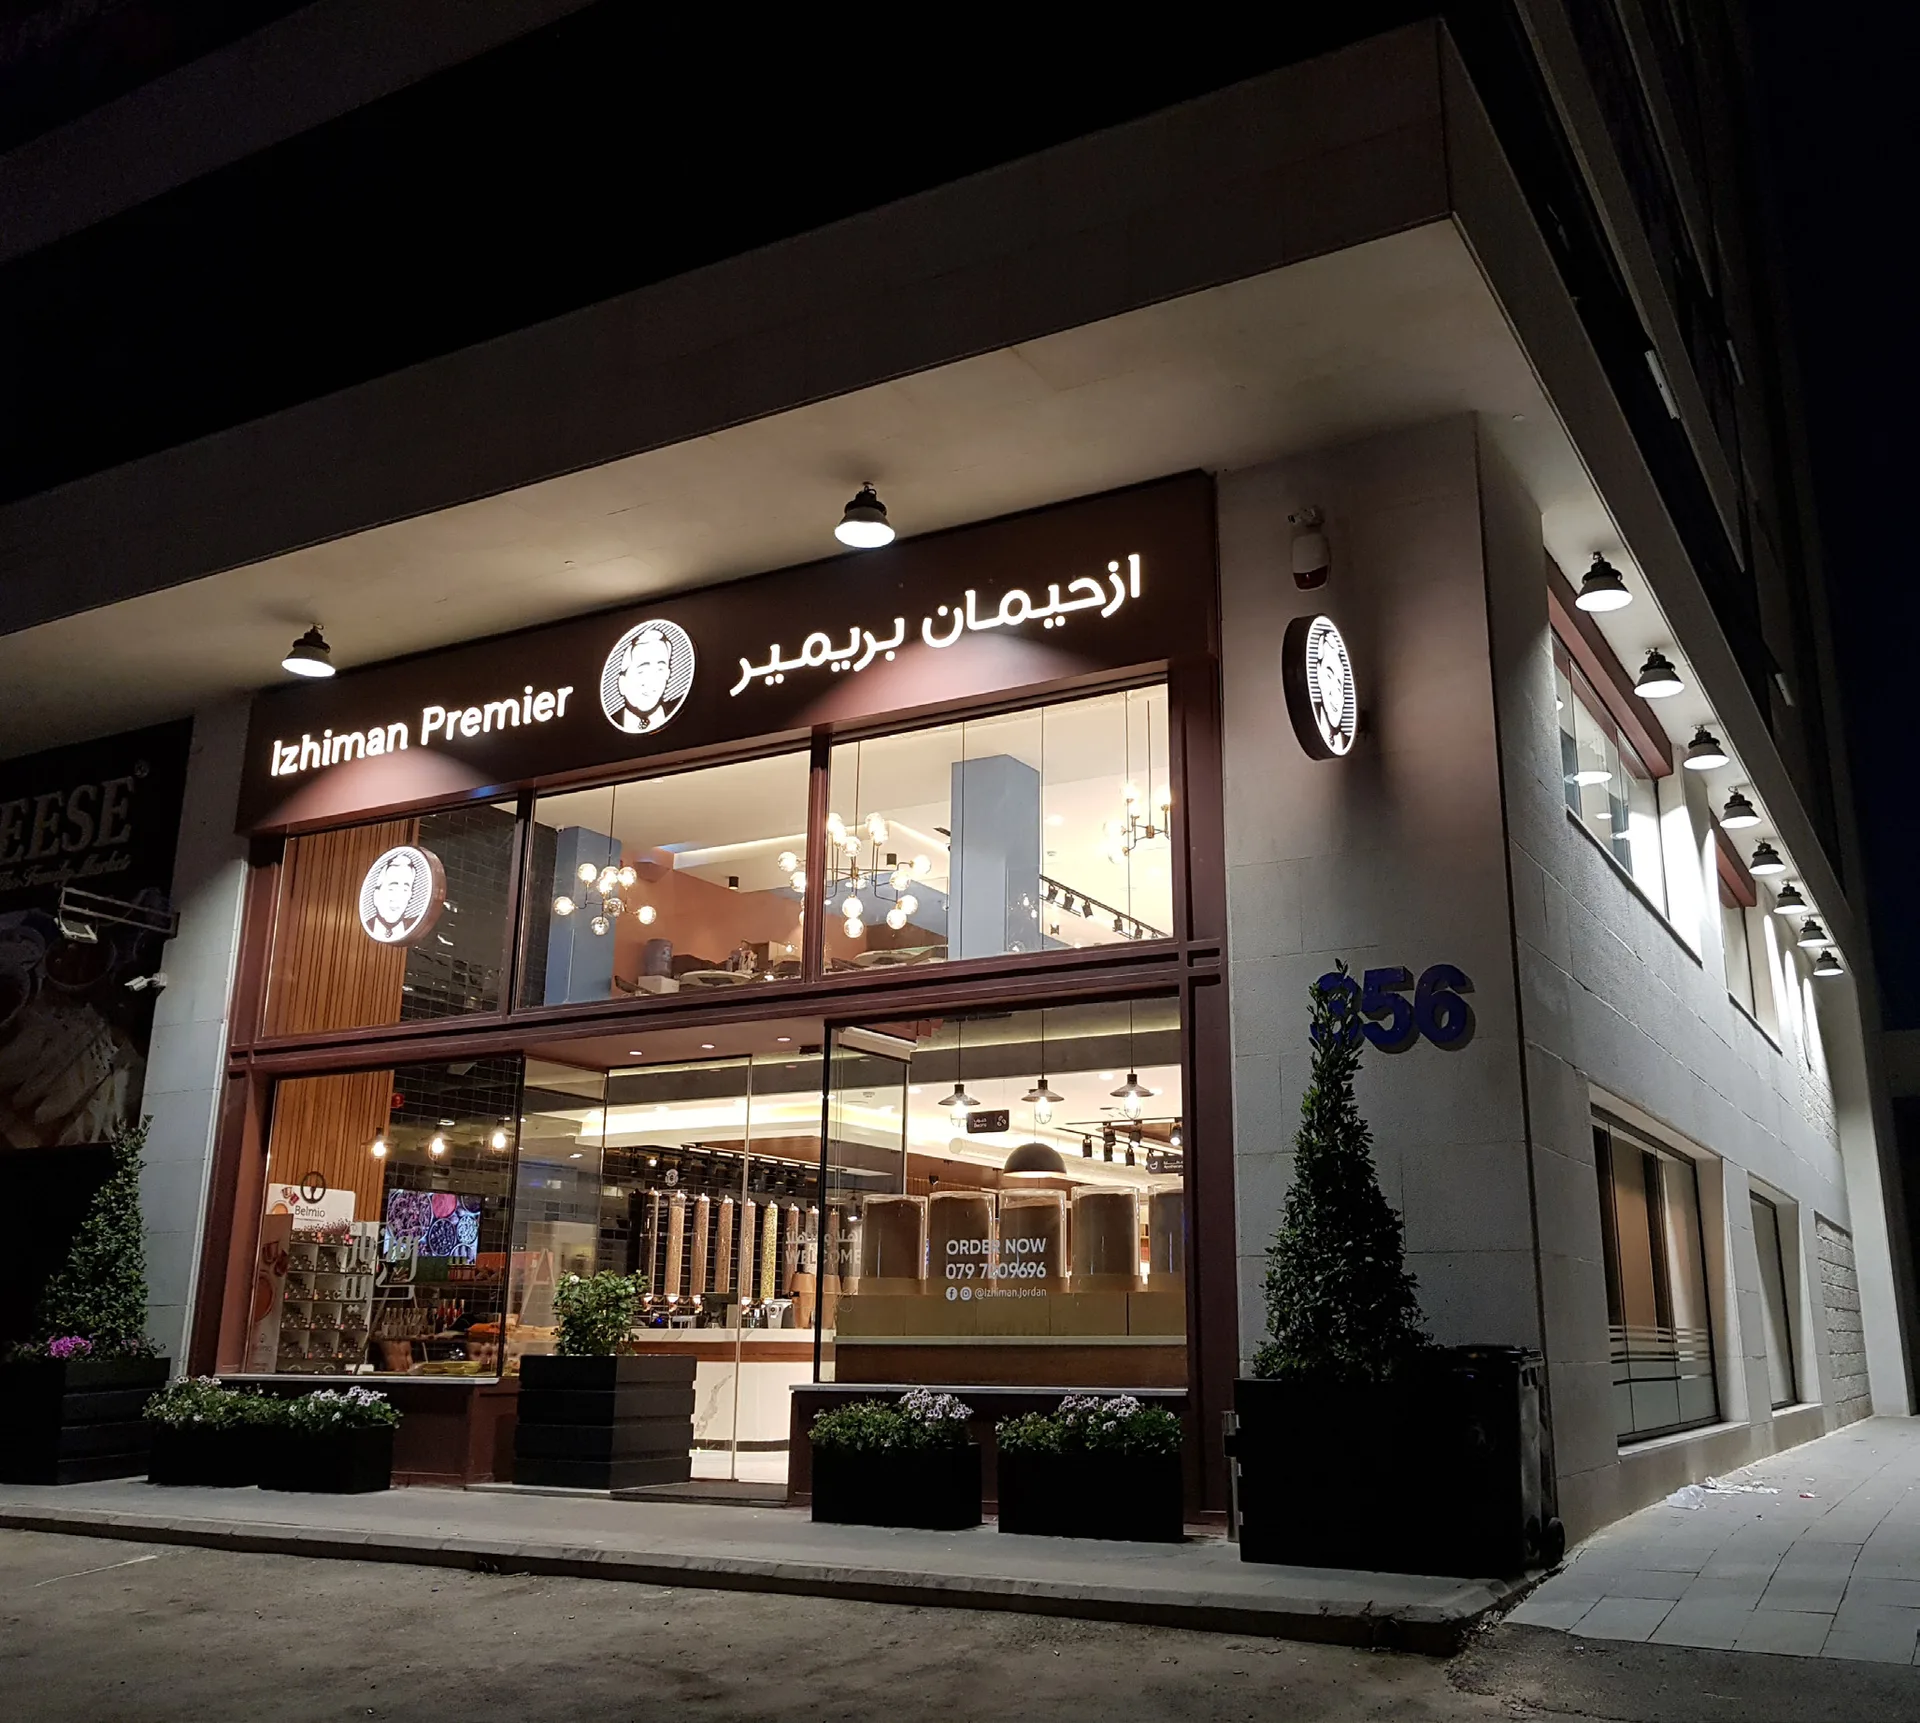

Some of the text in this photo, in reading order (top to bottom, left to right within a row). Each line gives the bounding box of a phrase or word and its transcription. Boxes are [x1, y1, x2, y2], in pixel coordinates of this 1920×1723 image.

[729, 553, 1141, 697] ازحيمان بريمير
[269, 685, 574, 777] Izhiman Premier
[294, 1205, 326, 1218] Belmio
[946, 1237, 1047, 1255] ORDER NOW
[945, 1263, 975, 1280] 079
